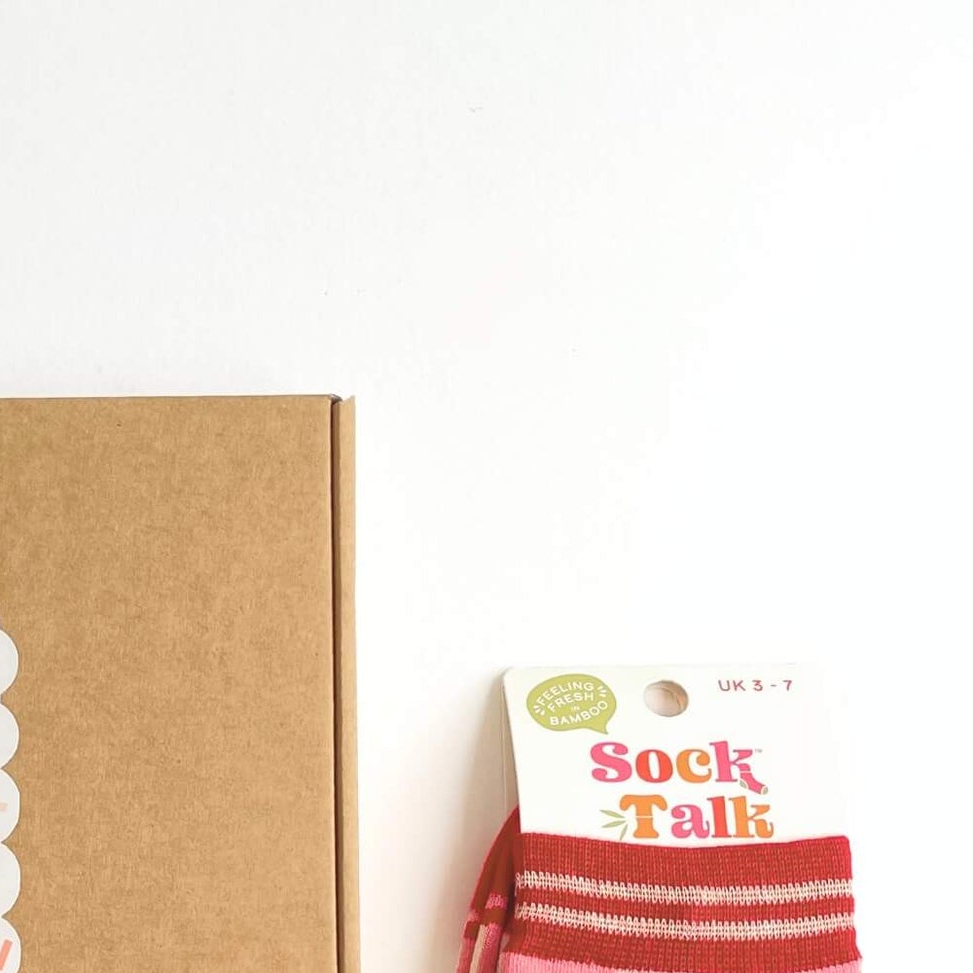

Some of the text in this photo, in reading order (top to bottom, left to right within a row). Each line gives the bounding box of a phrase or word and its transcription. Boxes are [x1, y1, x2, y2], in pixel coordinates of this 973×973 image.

[536, 681, 595, 706] FEELING
[718, 679, 746, 692] UK
[752, 679, 763, 692] 3
[782, 679, 792, 691] 7
[547, 692, 594, 713] FRESH
[550, 700, 609, 725] BAMBOO
[590, 740, 768, 795] Sock
[619, 794, 775, 840] Talk
